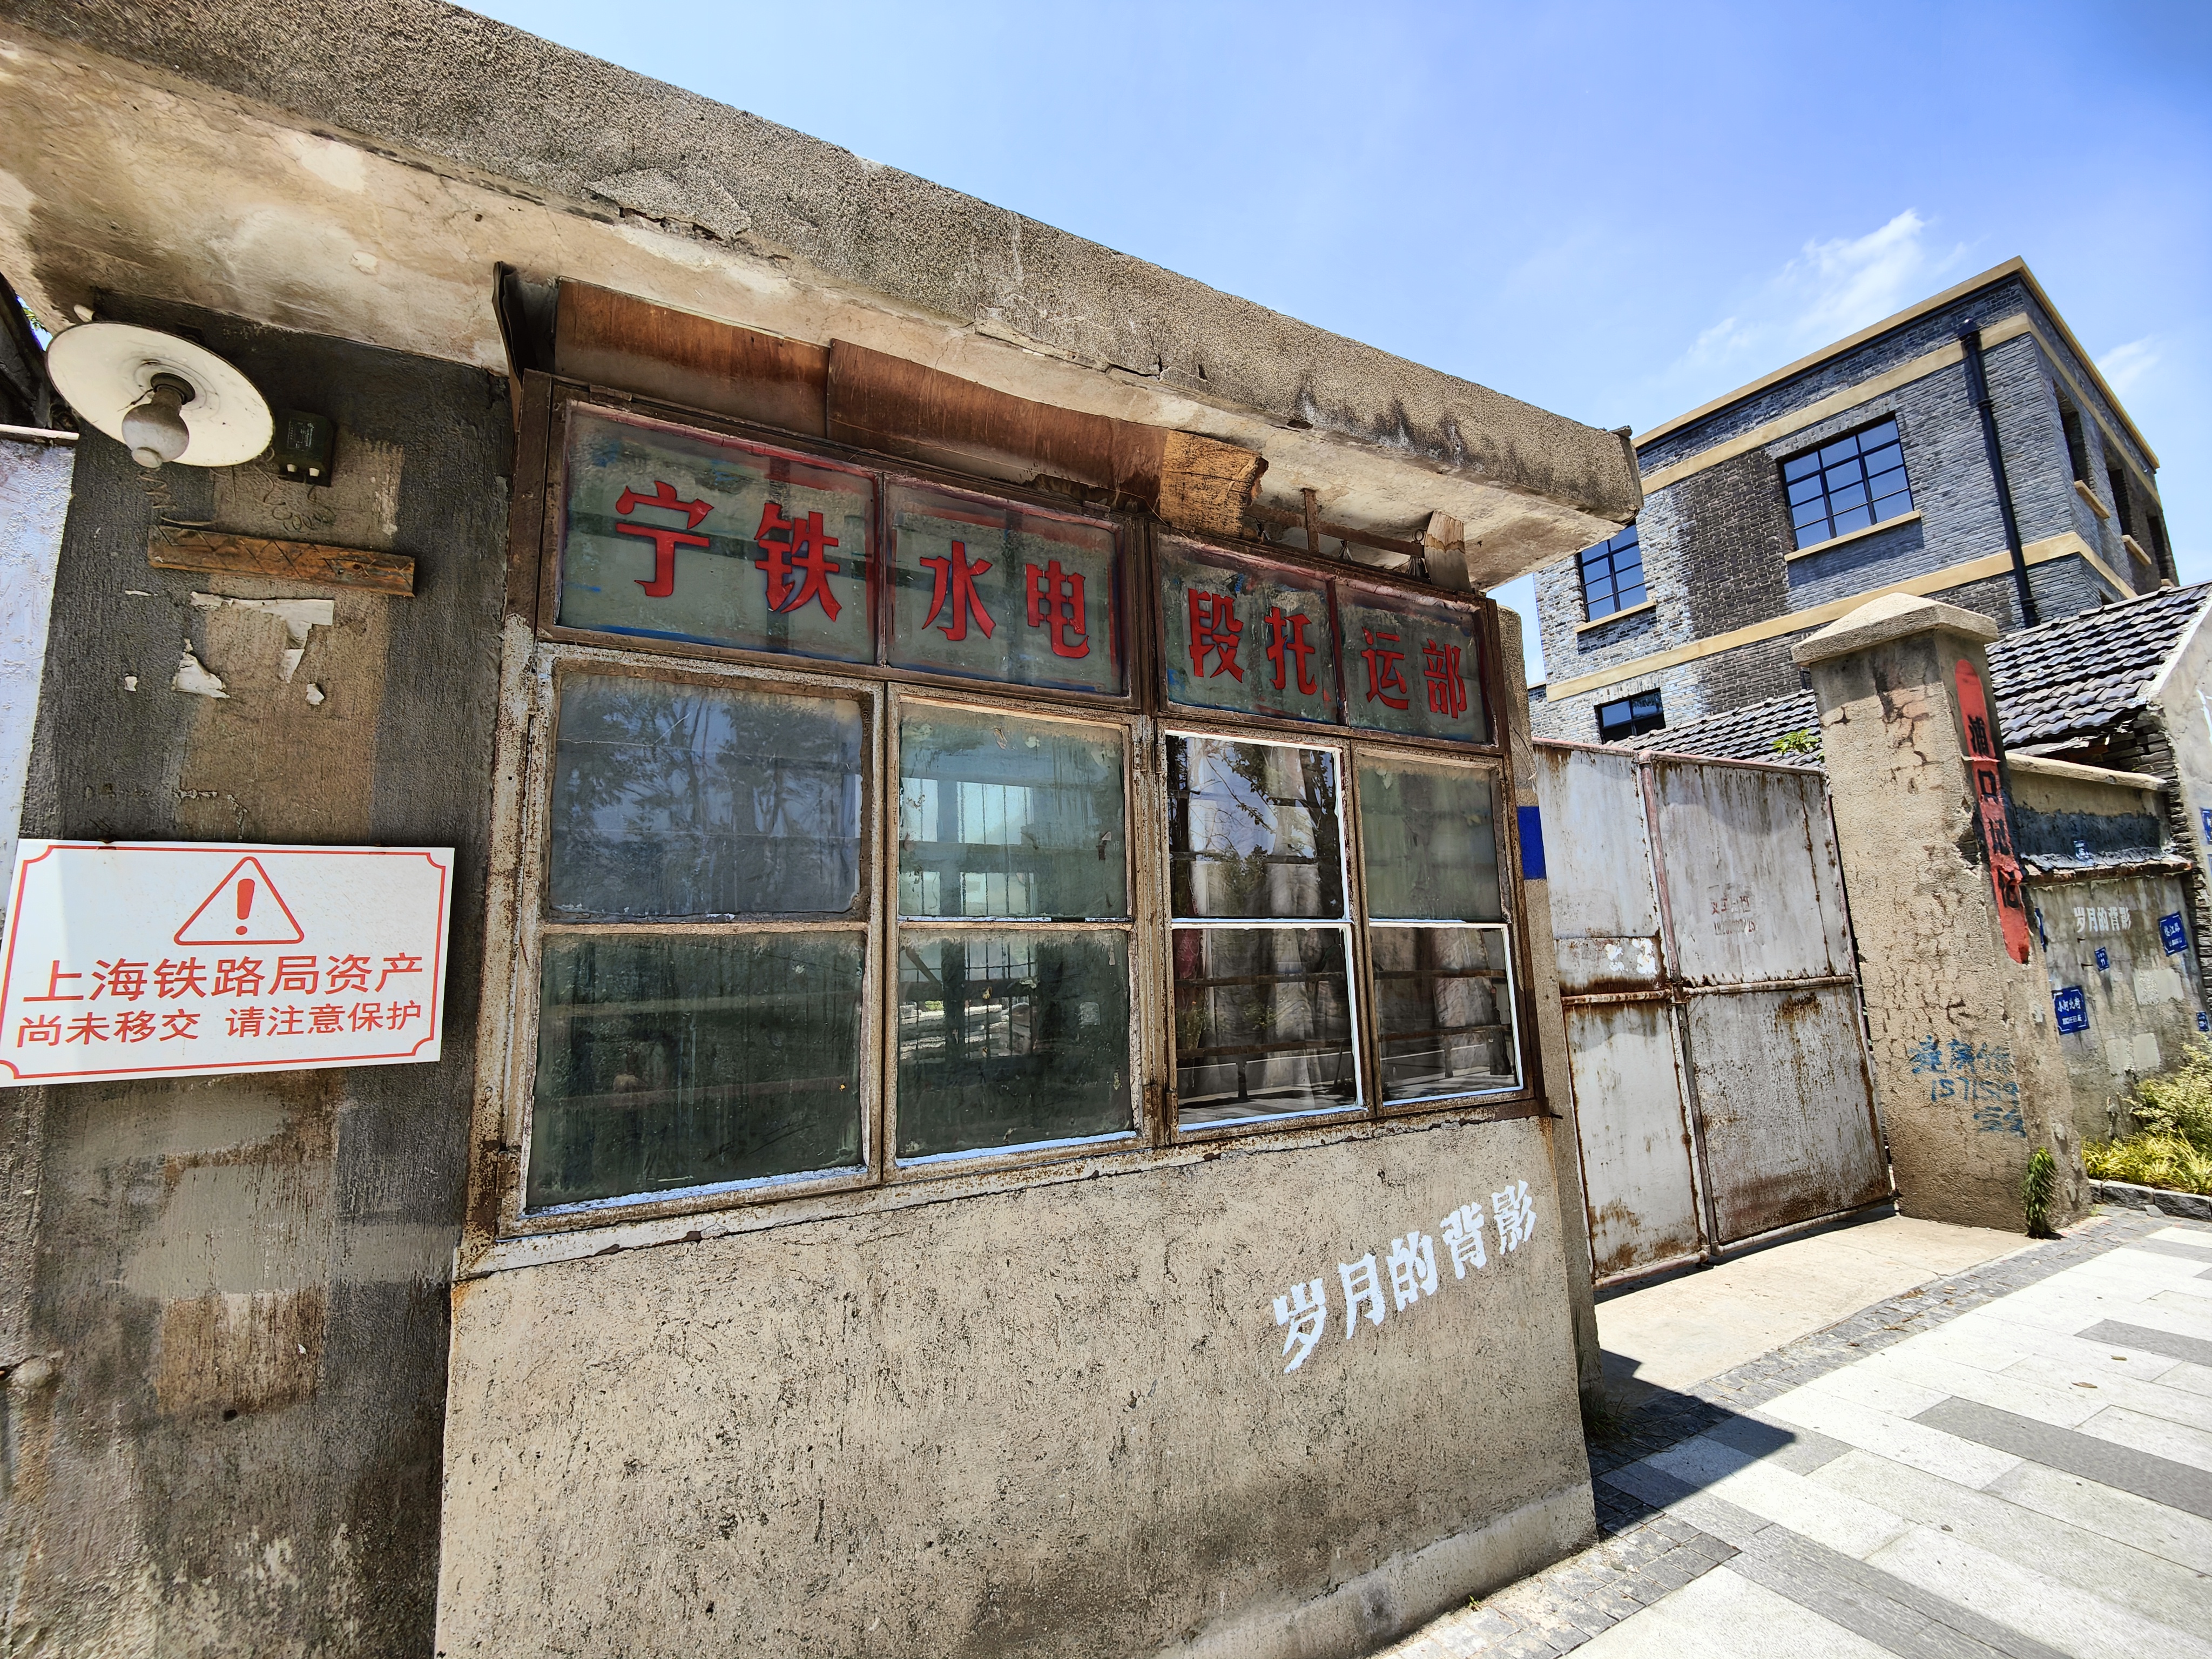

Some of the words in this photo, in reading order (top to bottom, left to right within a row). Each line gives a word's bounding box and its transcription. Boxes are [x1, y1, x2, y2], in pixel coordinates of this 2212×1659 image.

[615, 480, 1468, 719] 宁铁水电段托运部
[2073, 907, 2132, 933] 岁月的背影
[23, 952, 423, 1002] 上海铁路局资产
[17, 1008, 201, 1048] 尚未移交
[225, 1000, 422, 1038] 请注意保护
[1273, 1179, 1537, 1373] 岁月的背影
